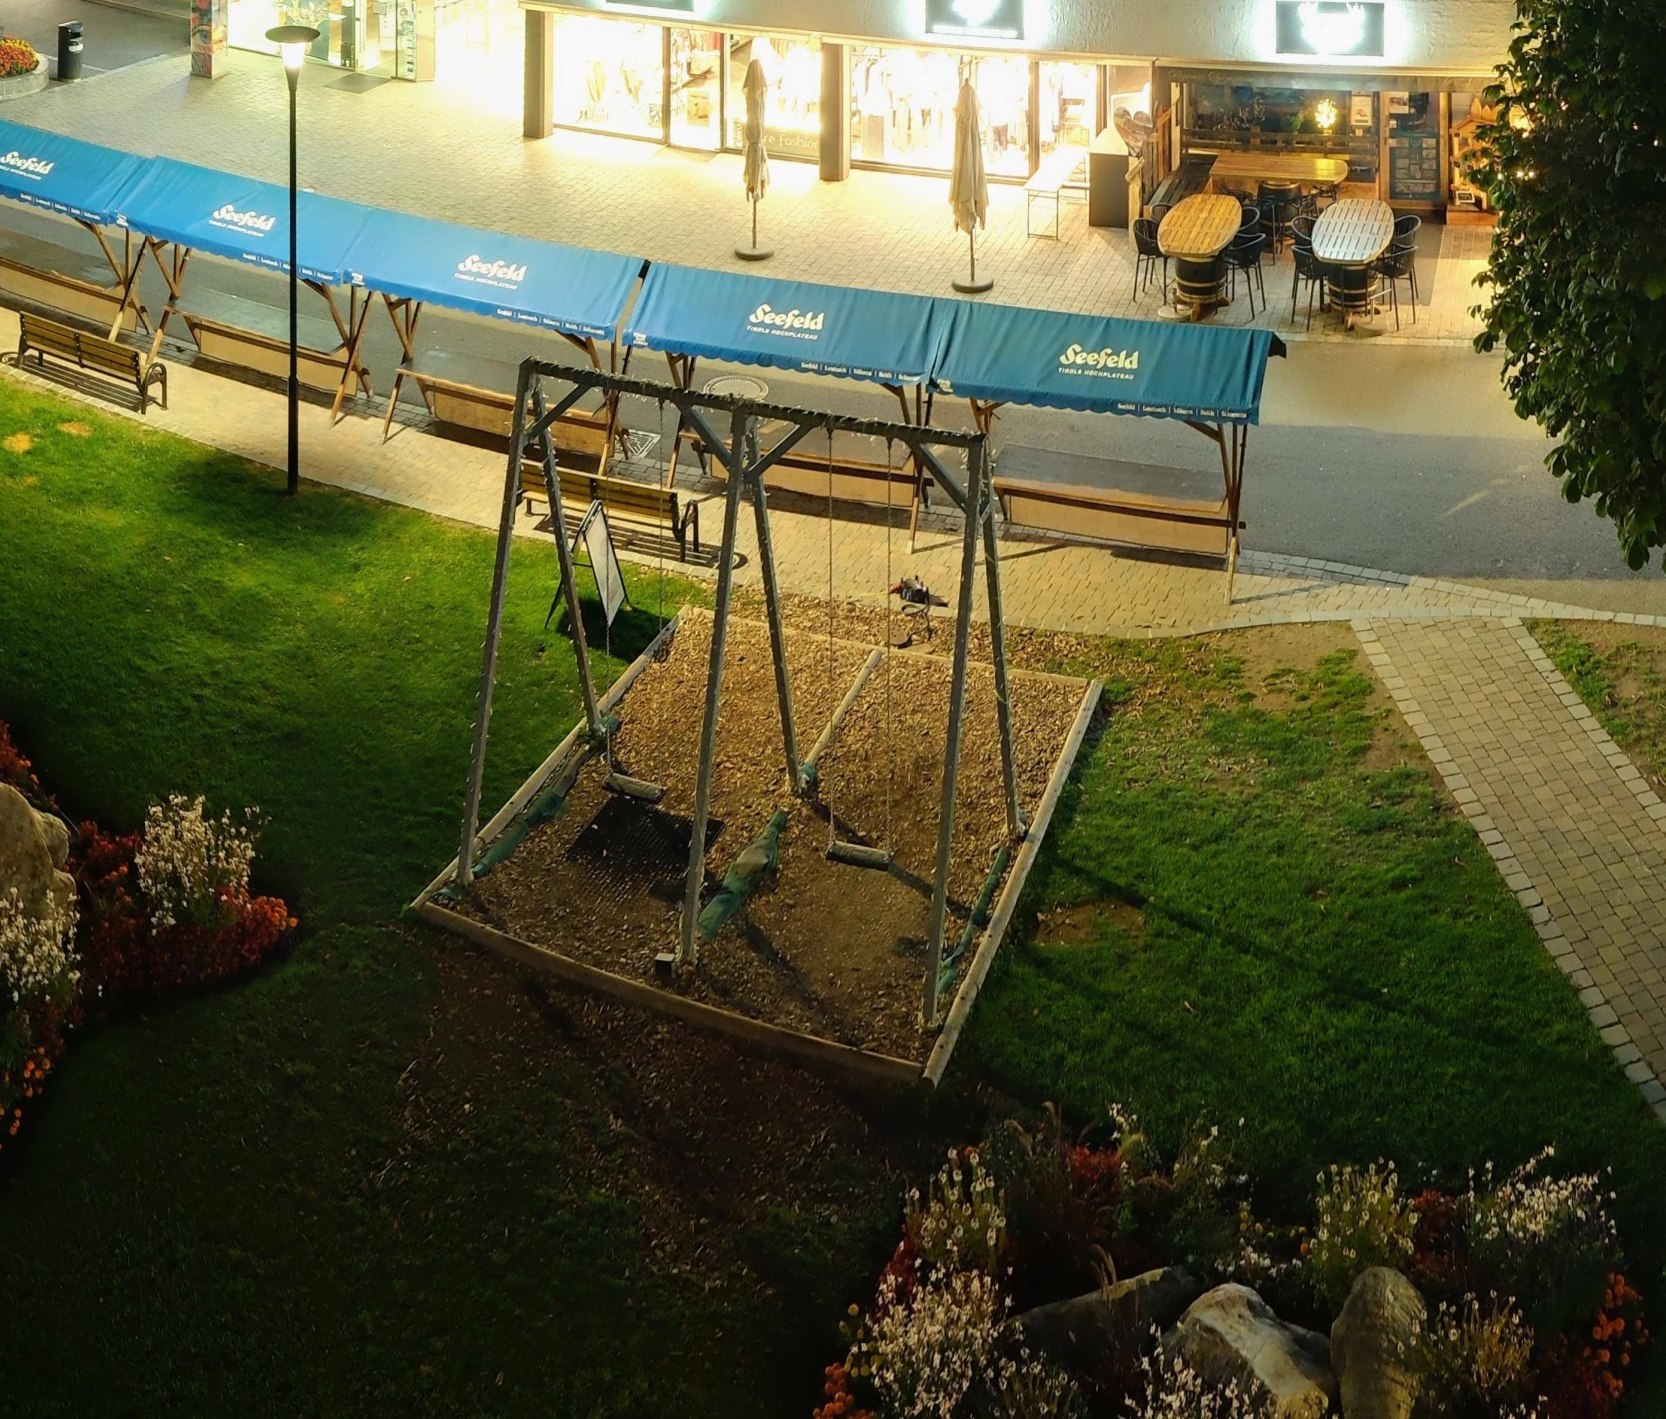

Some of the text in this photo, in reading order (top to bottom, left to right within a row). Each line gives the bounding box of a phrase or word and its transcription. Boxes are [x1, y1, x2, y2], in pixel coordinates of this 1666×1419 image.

[0, 152, 55, 175] Seefeld
[213, 204, 276, 231] Seefeld
[458, 254, 527, 282] Seefeld
[749, 303, 825, 331] Seefeld
[1059, 344, 1140, 370] Seefeld
[1084, 369, 1135, 380] HOCHPLATEAU
